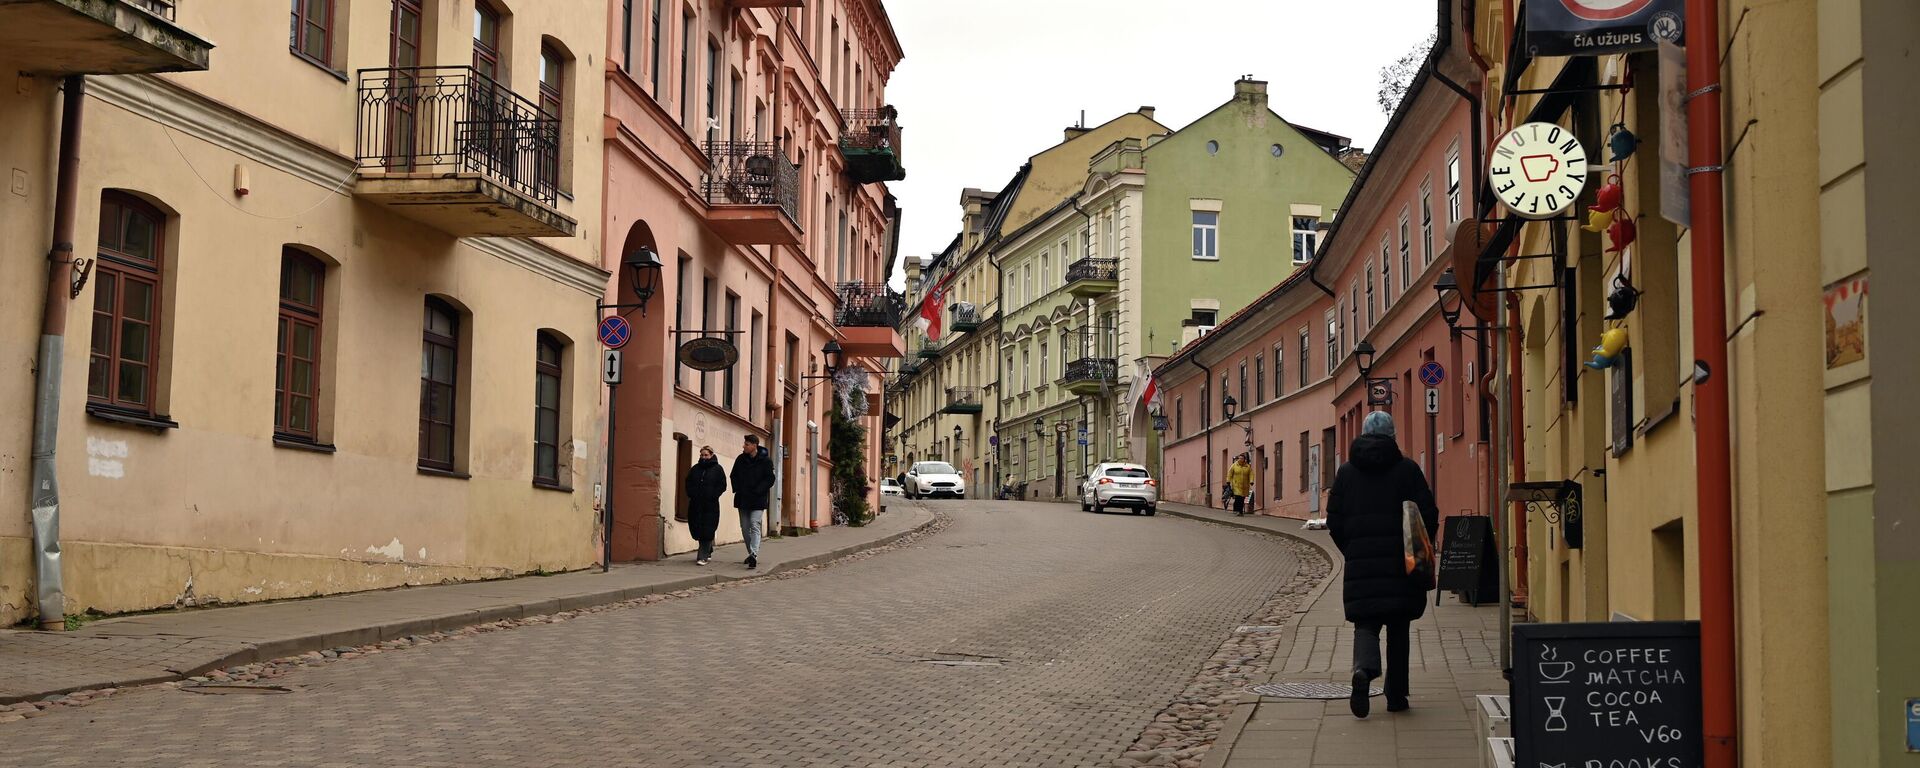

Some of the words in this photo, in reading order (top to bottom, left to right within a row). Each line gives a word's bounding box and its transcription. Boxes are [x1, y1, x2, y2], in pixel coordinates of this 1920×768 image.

[1574, 34, 1594, 47] ČIA
[1597, 32, 1642, 45] UŽUPIS
[1496, 124, 1539, 160] NOT
[1548, 127, 1585, 183] ONLY
[1492, 166, 1575, 213] COFFEE
[1373, 387, 1386, 395] 20
[1583, 648, 1671, 664] COFFEE
[1584, 667, 1685, 685] MATCHA
[1586, 690, 1663, 707] COCOA
[1589, 710, 1639, 727] TEA
[1639, 724, 1683, 743] V60
